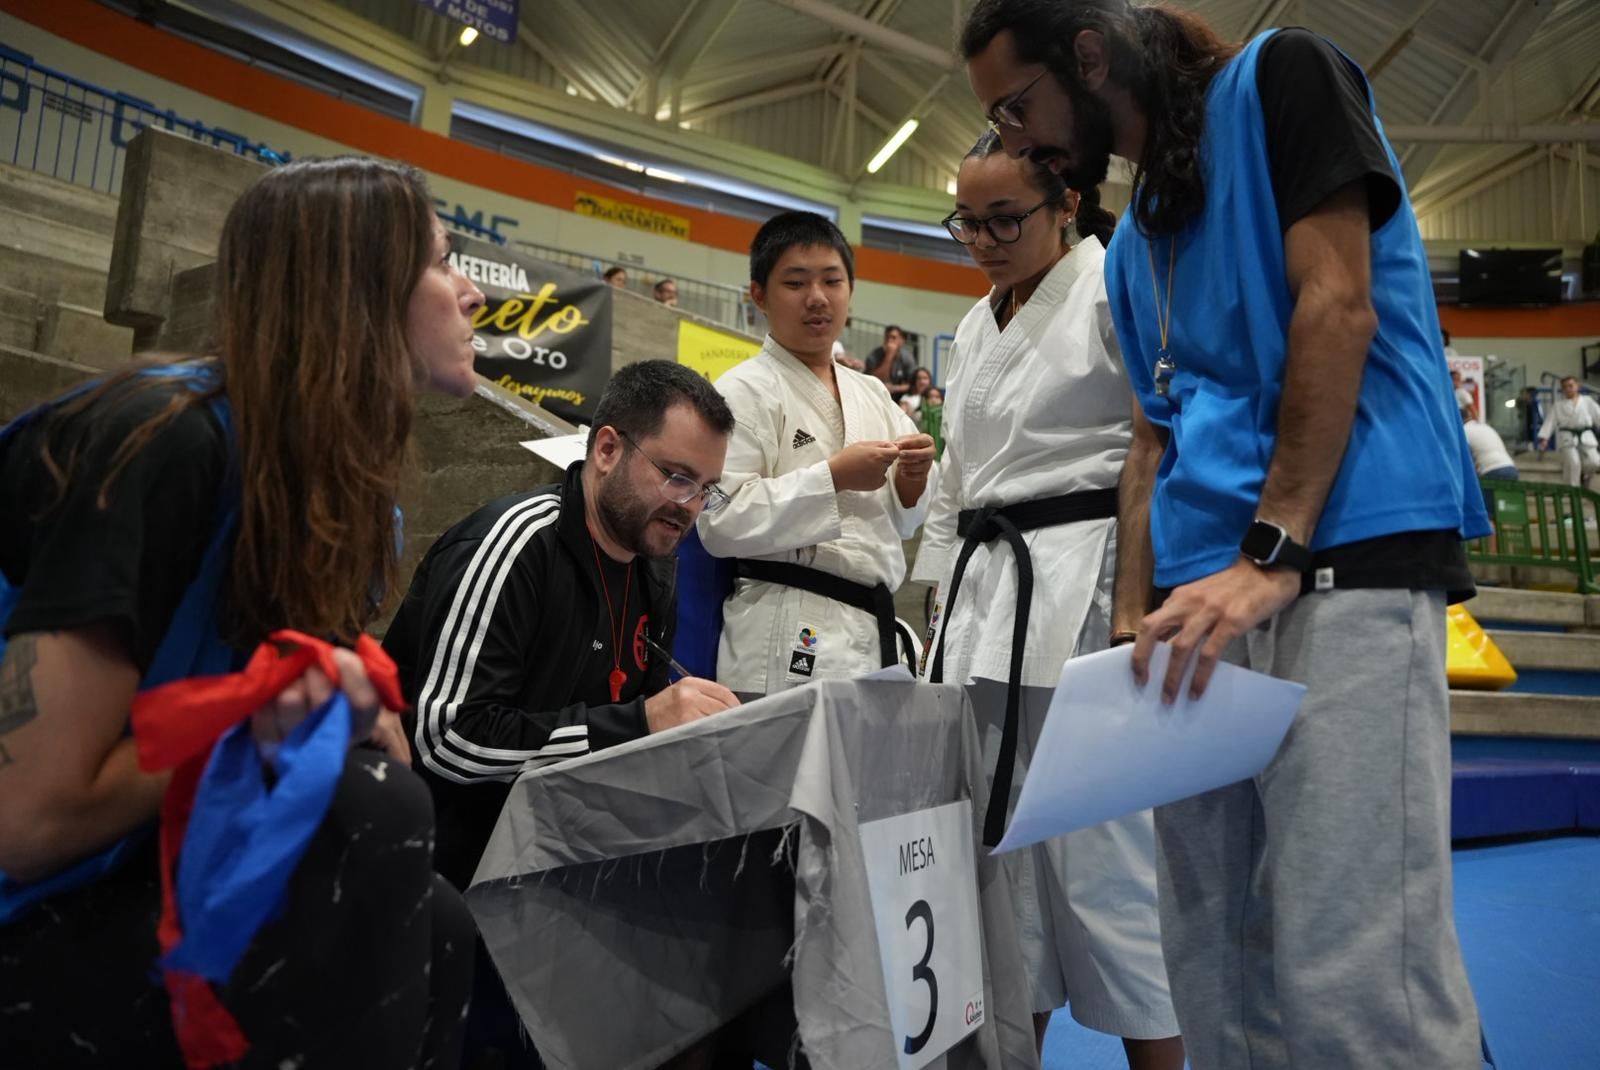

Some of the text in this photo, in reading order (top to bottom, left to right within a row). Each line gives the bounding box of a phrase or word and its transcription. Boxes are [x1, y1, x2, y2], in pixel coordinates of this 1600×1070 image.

[447, 3, 509, 41] MOTOS
[448, 252, 531, 293] AFETERÍA
[502, 337, 568, 370] Oro
[899, 836, 936, 876] MESA
[903, 899, 939, 1056] 3
